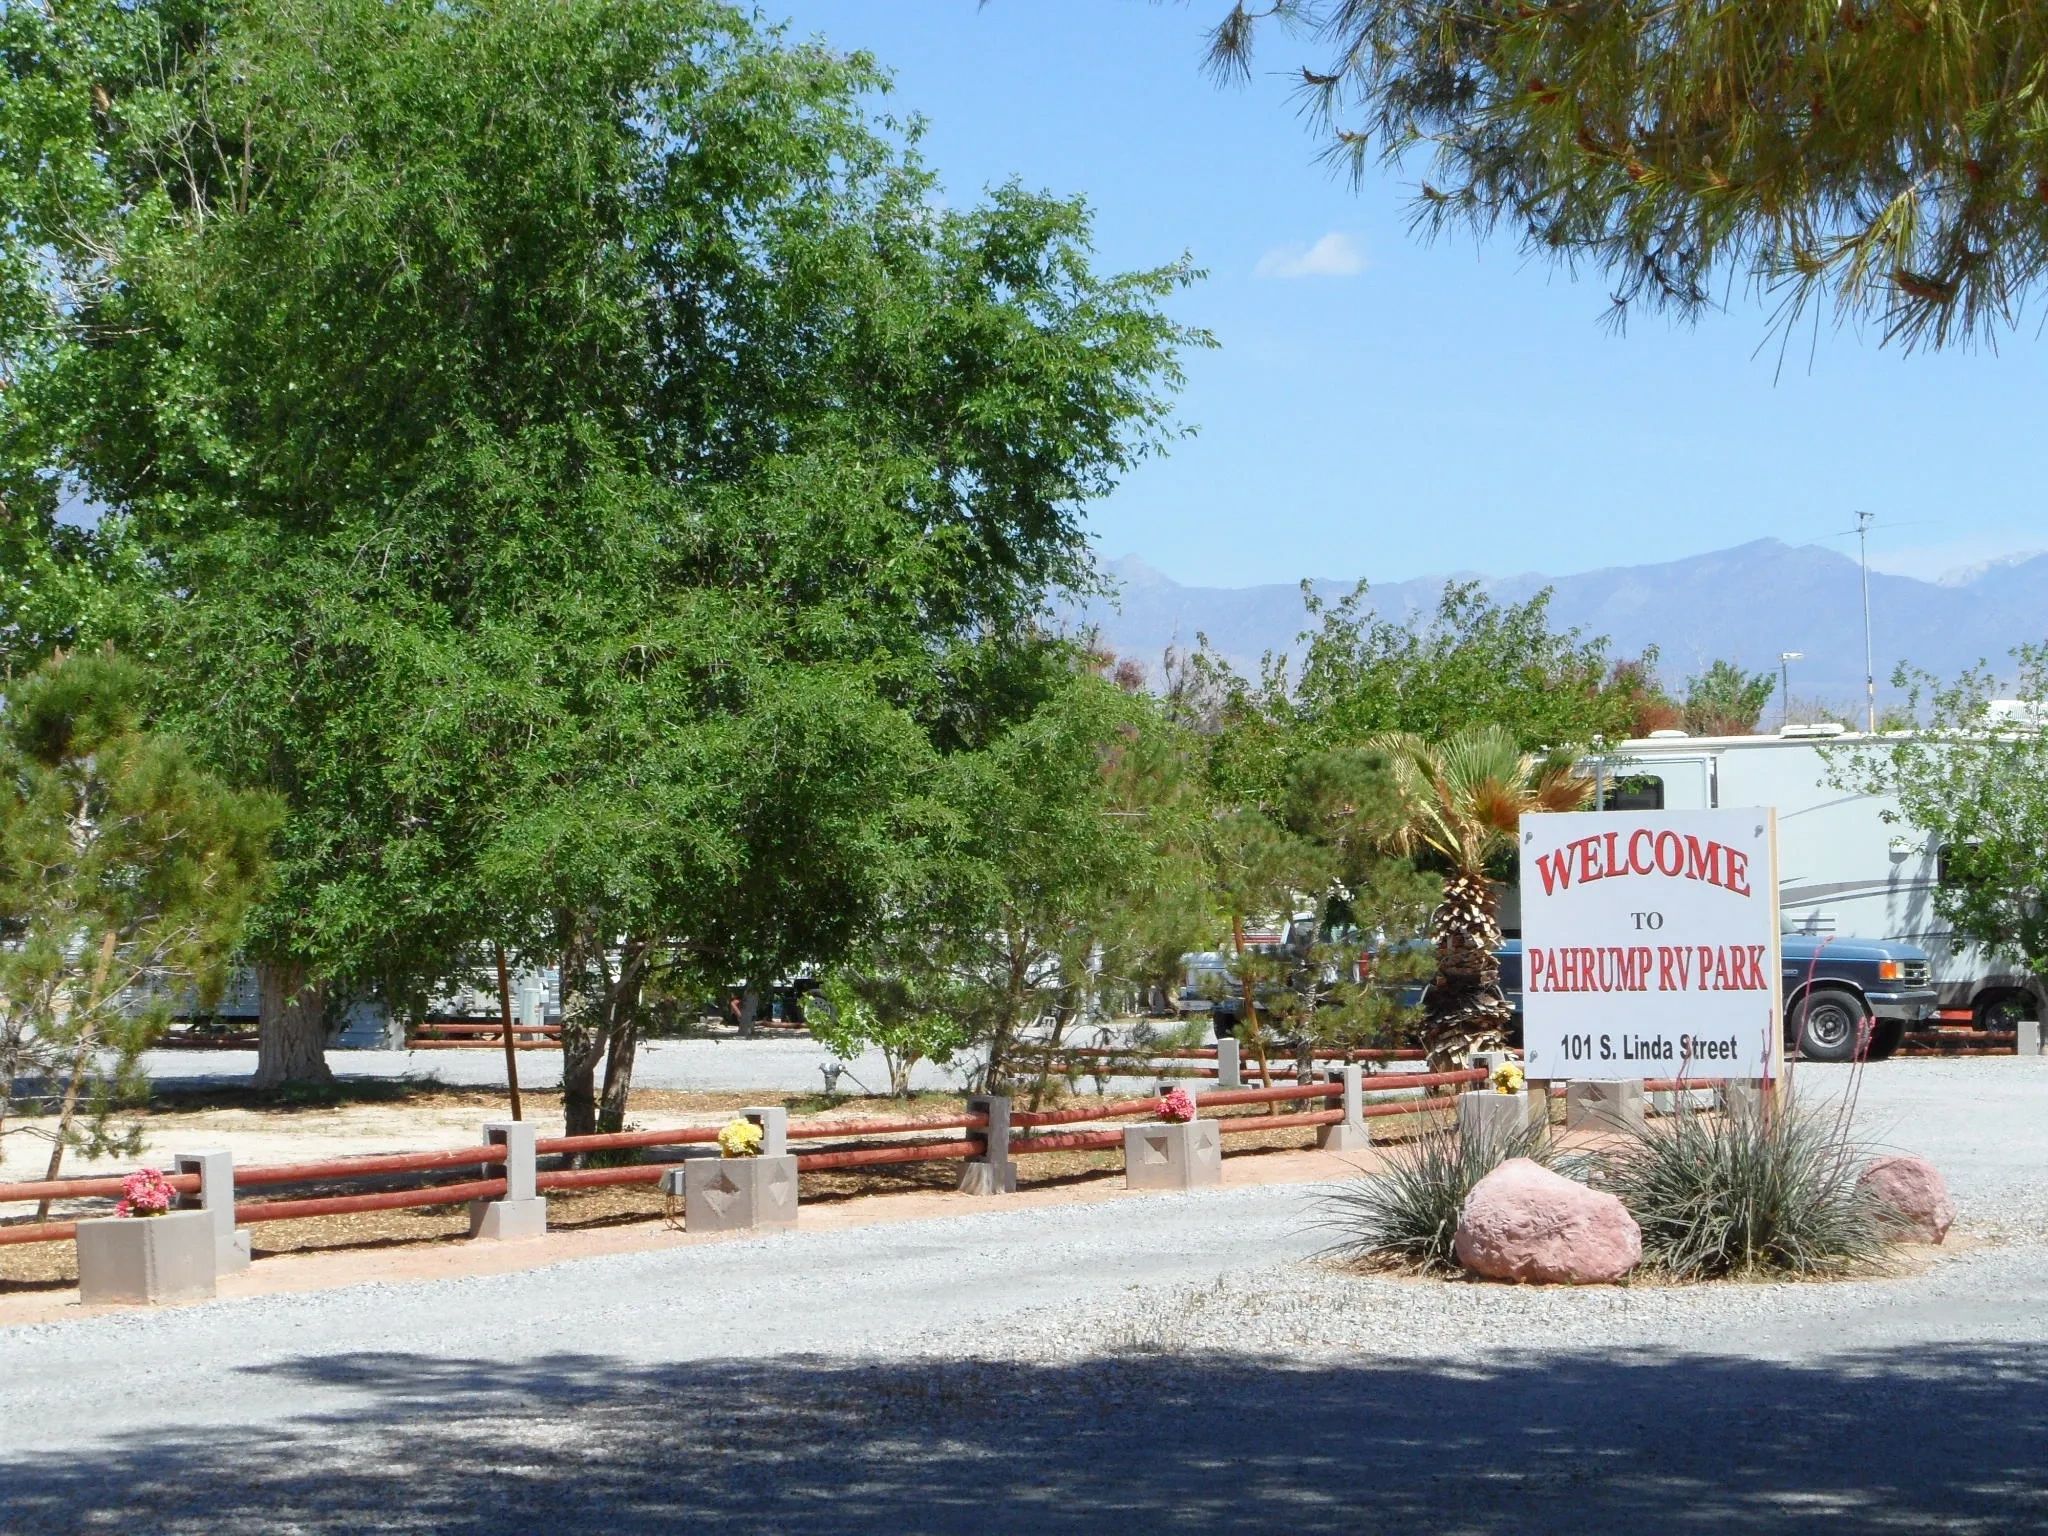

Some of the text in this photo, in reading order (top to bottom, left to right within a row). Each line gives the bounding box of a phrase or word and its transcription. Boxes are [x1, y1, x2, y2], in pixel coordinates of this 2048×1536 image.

[1535, 828, 1751, 898] WELCOME
[1631, 912, 1664, 930] TO
[1528, 945, 1768, 992] PAHRUMP RV PARK
[1561, 1034, 1738, 1060] 101 S. Linda Street
